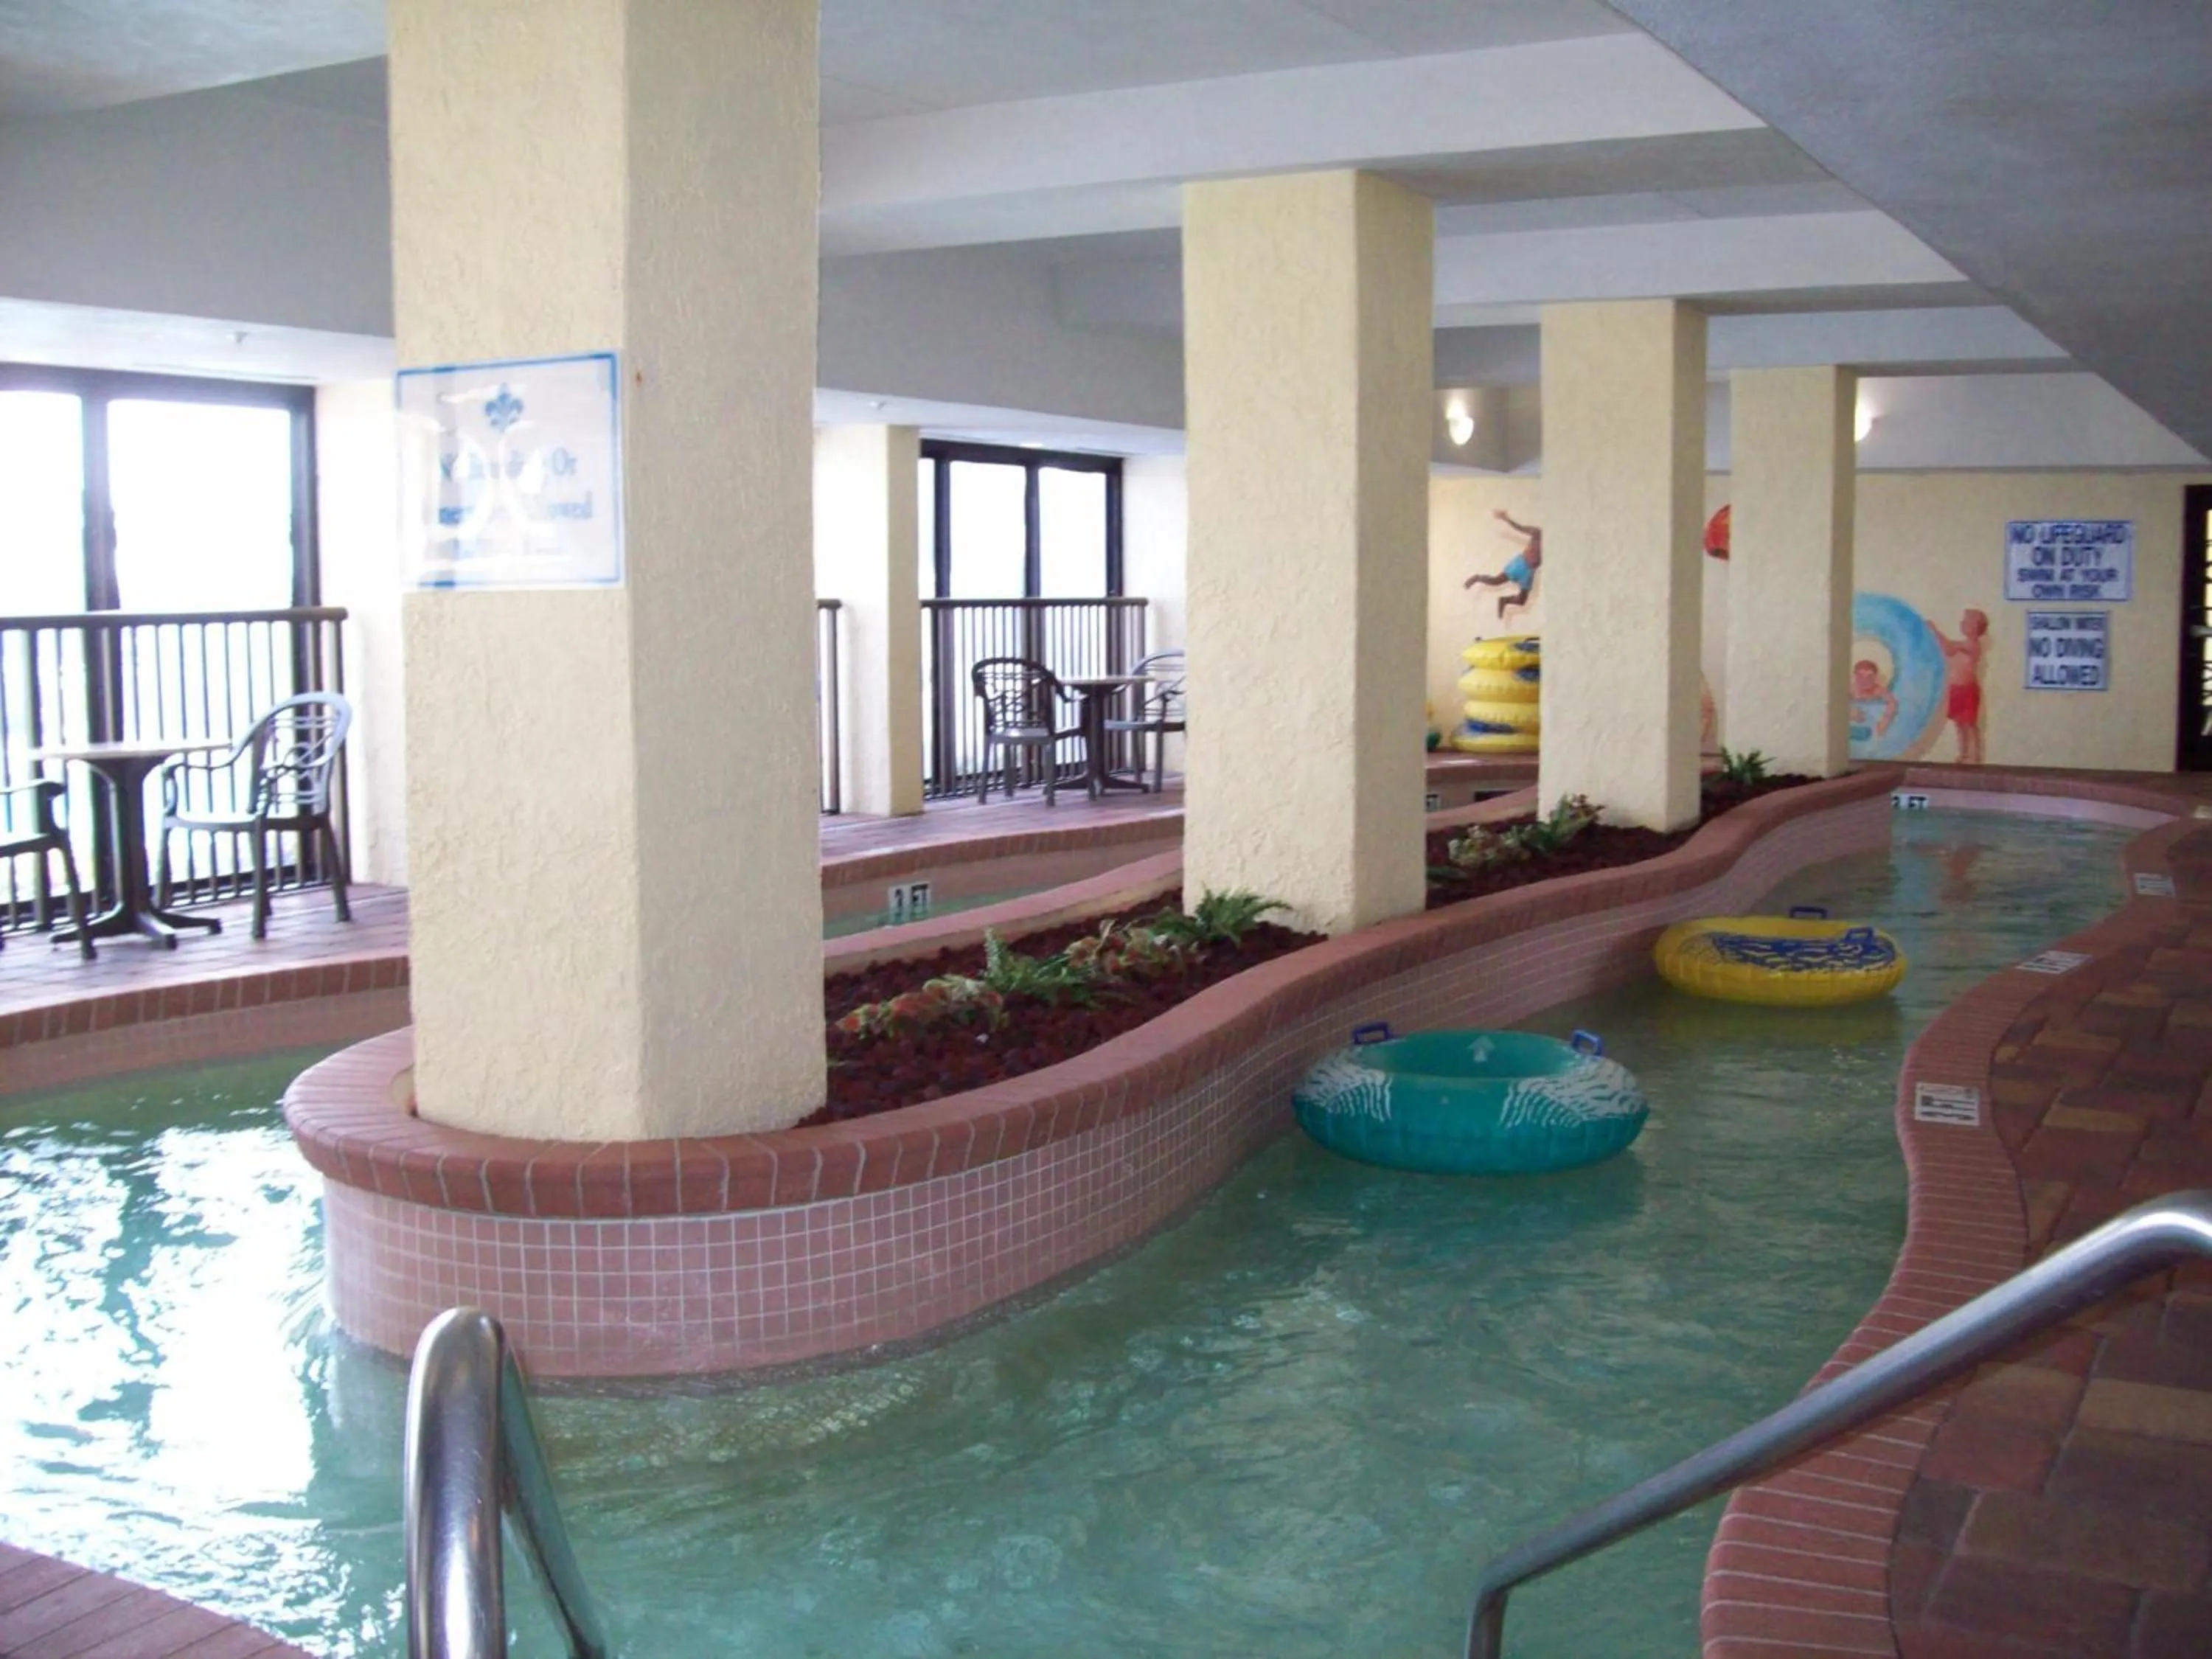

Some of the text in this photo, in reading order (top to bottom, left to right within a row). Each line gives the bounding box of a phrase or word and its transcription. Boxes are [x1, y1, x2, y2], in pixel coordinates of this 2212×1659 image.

[2010, 524, 2126, 544] NO LIFEGUARD
[2032, 546, 2103, 566] ON DUTY
[2017, 568, 2120, 582] SWIM AT YOUR
[2031, 584, 2101, 598] OWN RISK
[2028, 637, 2104, 658] NO DIVING
[2031, 664, 2101, 686] ALLOWED
